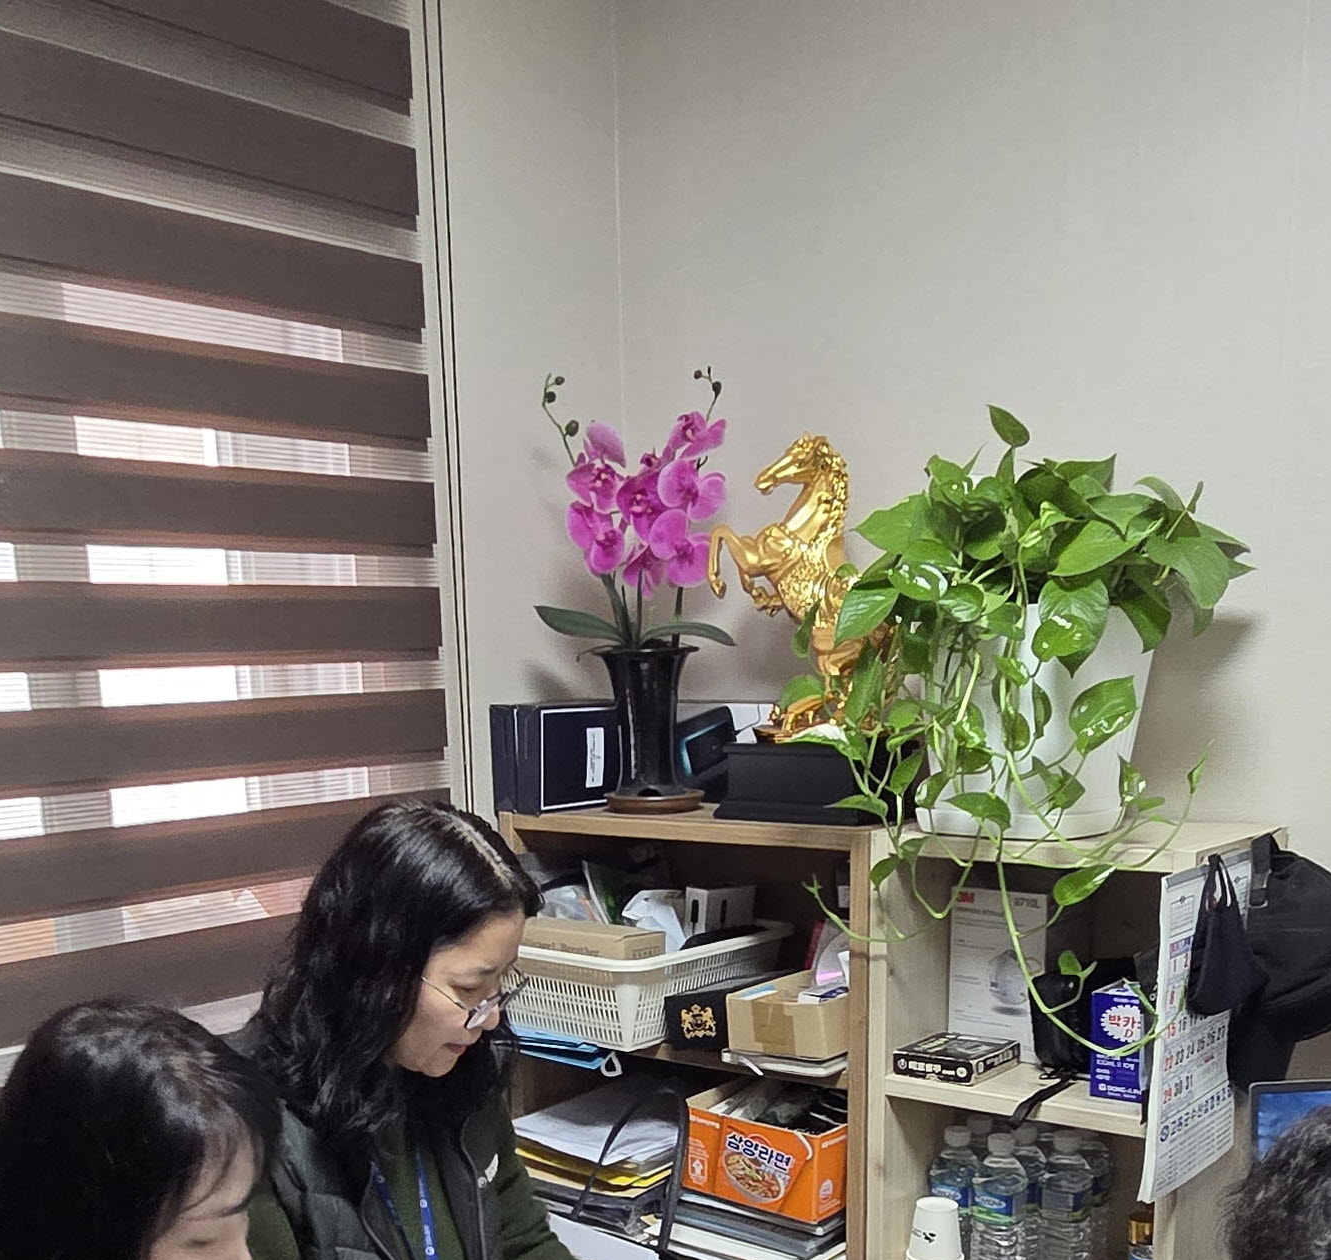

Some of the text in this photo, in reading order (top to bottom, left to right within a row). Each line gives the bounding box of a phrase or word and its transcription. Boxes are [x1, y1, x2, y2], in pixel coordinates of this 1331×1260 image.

[1109, 1014, 1142, 1030] 박카
[1124, 1029, 1134, 1039] D
[1164, 1055, 1174, 1072] 22
[1175, 1048, 1185, 1066] 23
[1186, 1042, 1195, 1060] 24
[1216, 1024, 1226, 1041] 27
[1163, 1073, 1193, 1105] 29 30 31
[726, 1131, 792, 1172] 삼양라면
